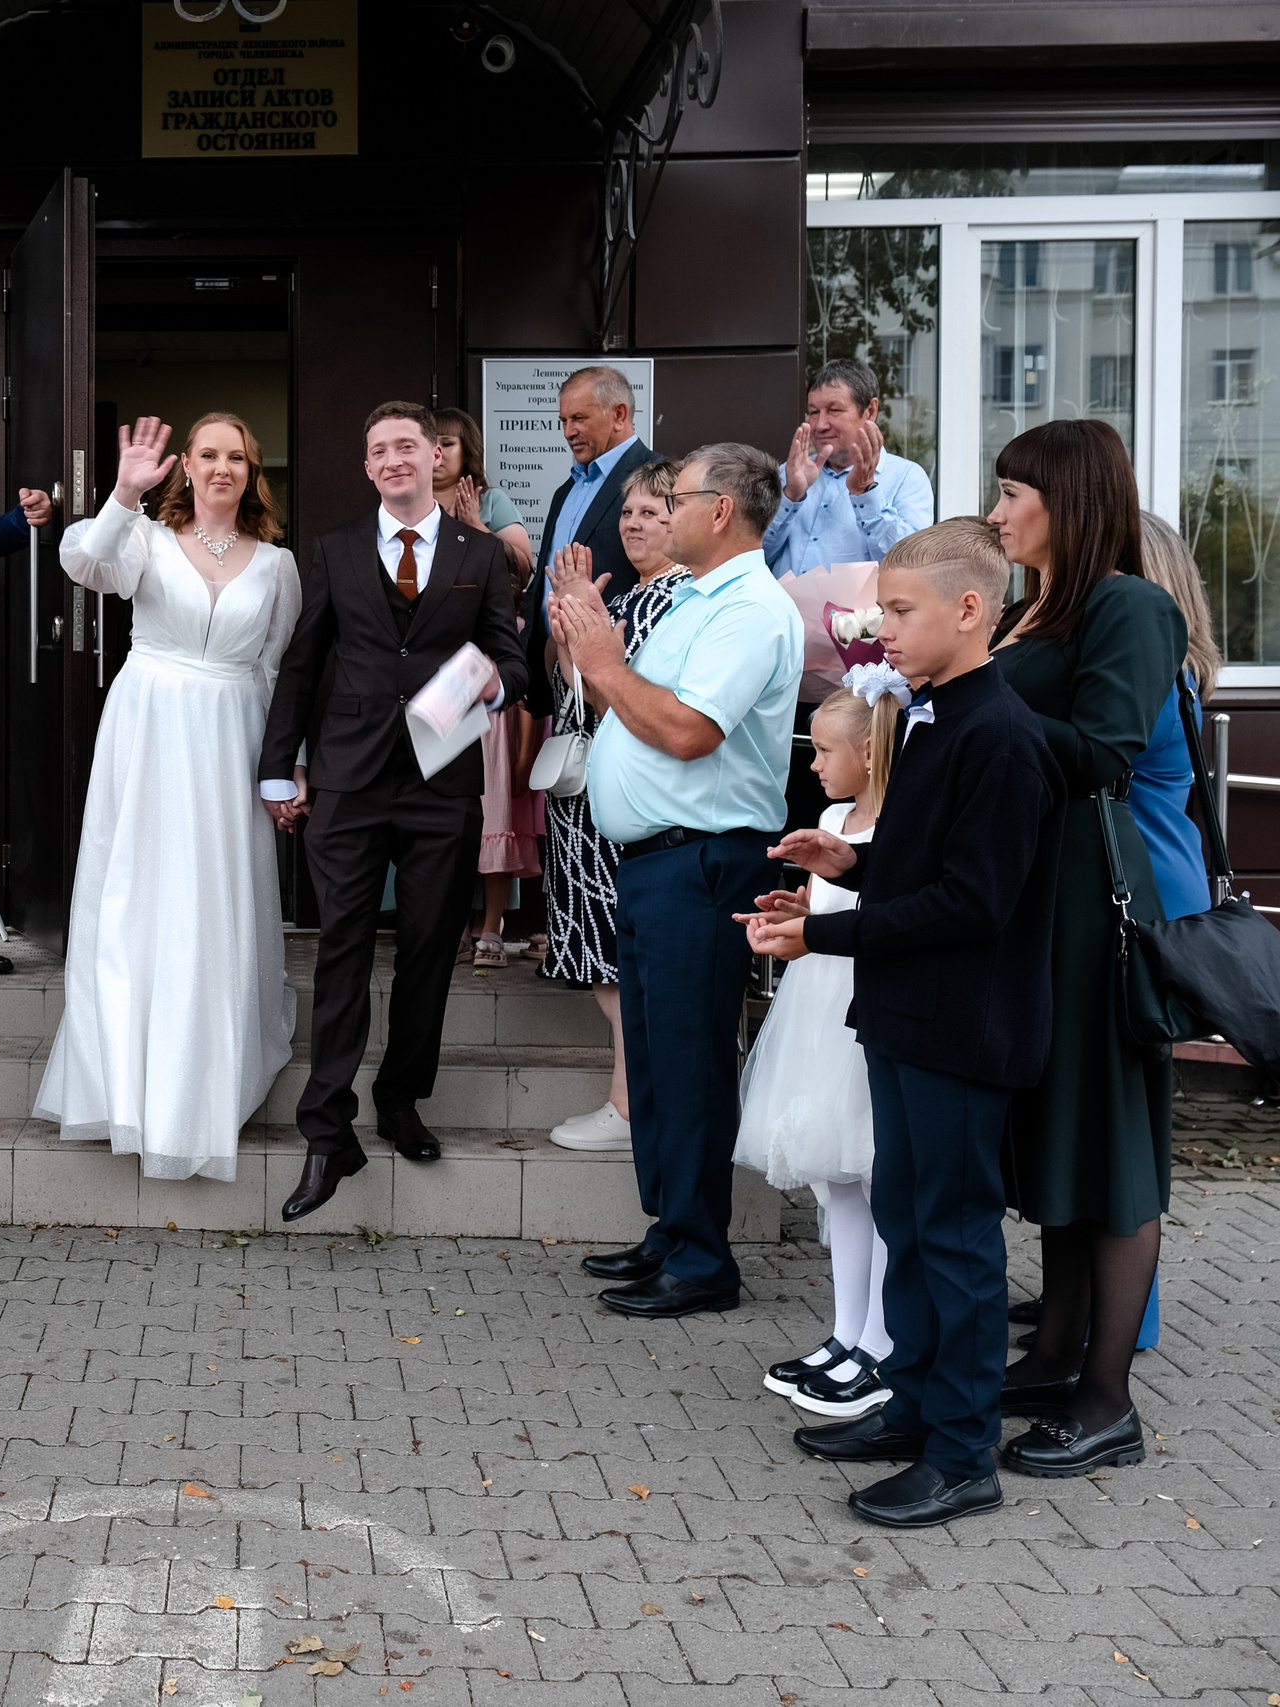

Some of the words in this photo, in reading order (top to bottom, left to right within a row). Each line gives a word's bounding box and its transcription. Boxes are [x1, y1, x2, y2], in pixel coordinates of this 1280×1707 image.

[153, 40, 239, 50] АДМИНИСТРАЦИЯ
[241, 39, 307, 49] ЛЕНИНСКОГО
[308, 37, 346, 48] РАЙОНА
[197, 50, 235, 60] ГОРОДА
[239, 49, 304, 59] ЧЕЛЯБИНСКА
[213, 67, 286, 89] ОТДЕЛ
[167, 89, 256, 108] ЗАПИСИ
[262, 88, 334, 107] АКТОВ
[161, 110, 338, 132] ГРАЖДАНСКОГО
[196, 132, 316, 151] ОСТОЯНИЯ
[495, 381, 546, 392] Управления
[528, 396, 557, 405] города
[500, 419, 553, 431] ПРИЕМ
[500, 443, 567, 454] Понедельник
[500, 461, 544, 472] Вторник
[499, 478, 531, 490] Среда
